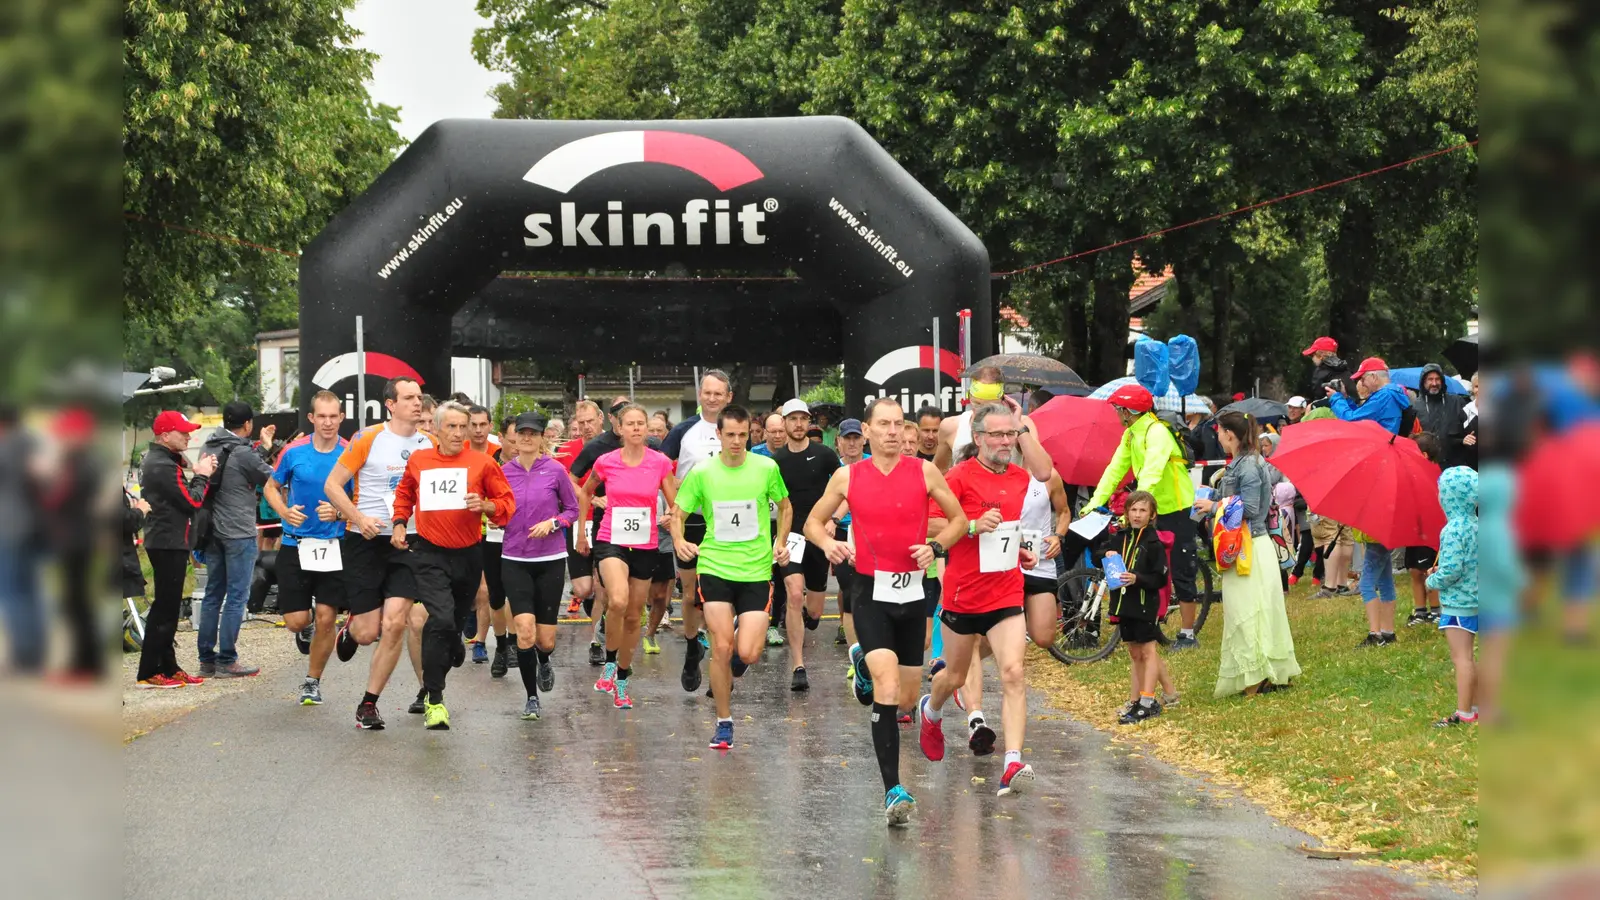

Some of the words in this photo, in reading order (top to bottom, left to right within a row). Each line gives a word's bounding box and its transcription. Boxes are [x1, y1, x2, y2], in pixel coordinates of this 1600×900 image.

[377, 197, 464, 279] www.skinfit.eu
[828, 197, 914, 278] www.skinfit.eu
[430, 479, 457, 494] 142
[624, 518, 640, 532] 35
[731, 513, 740, 527] 4
[1001, 536, 1010, 553] 7
[312, 547, 328, 560] 17
[891, 572, 911, 589] 20
